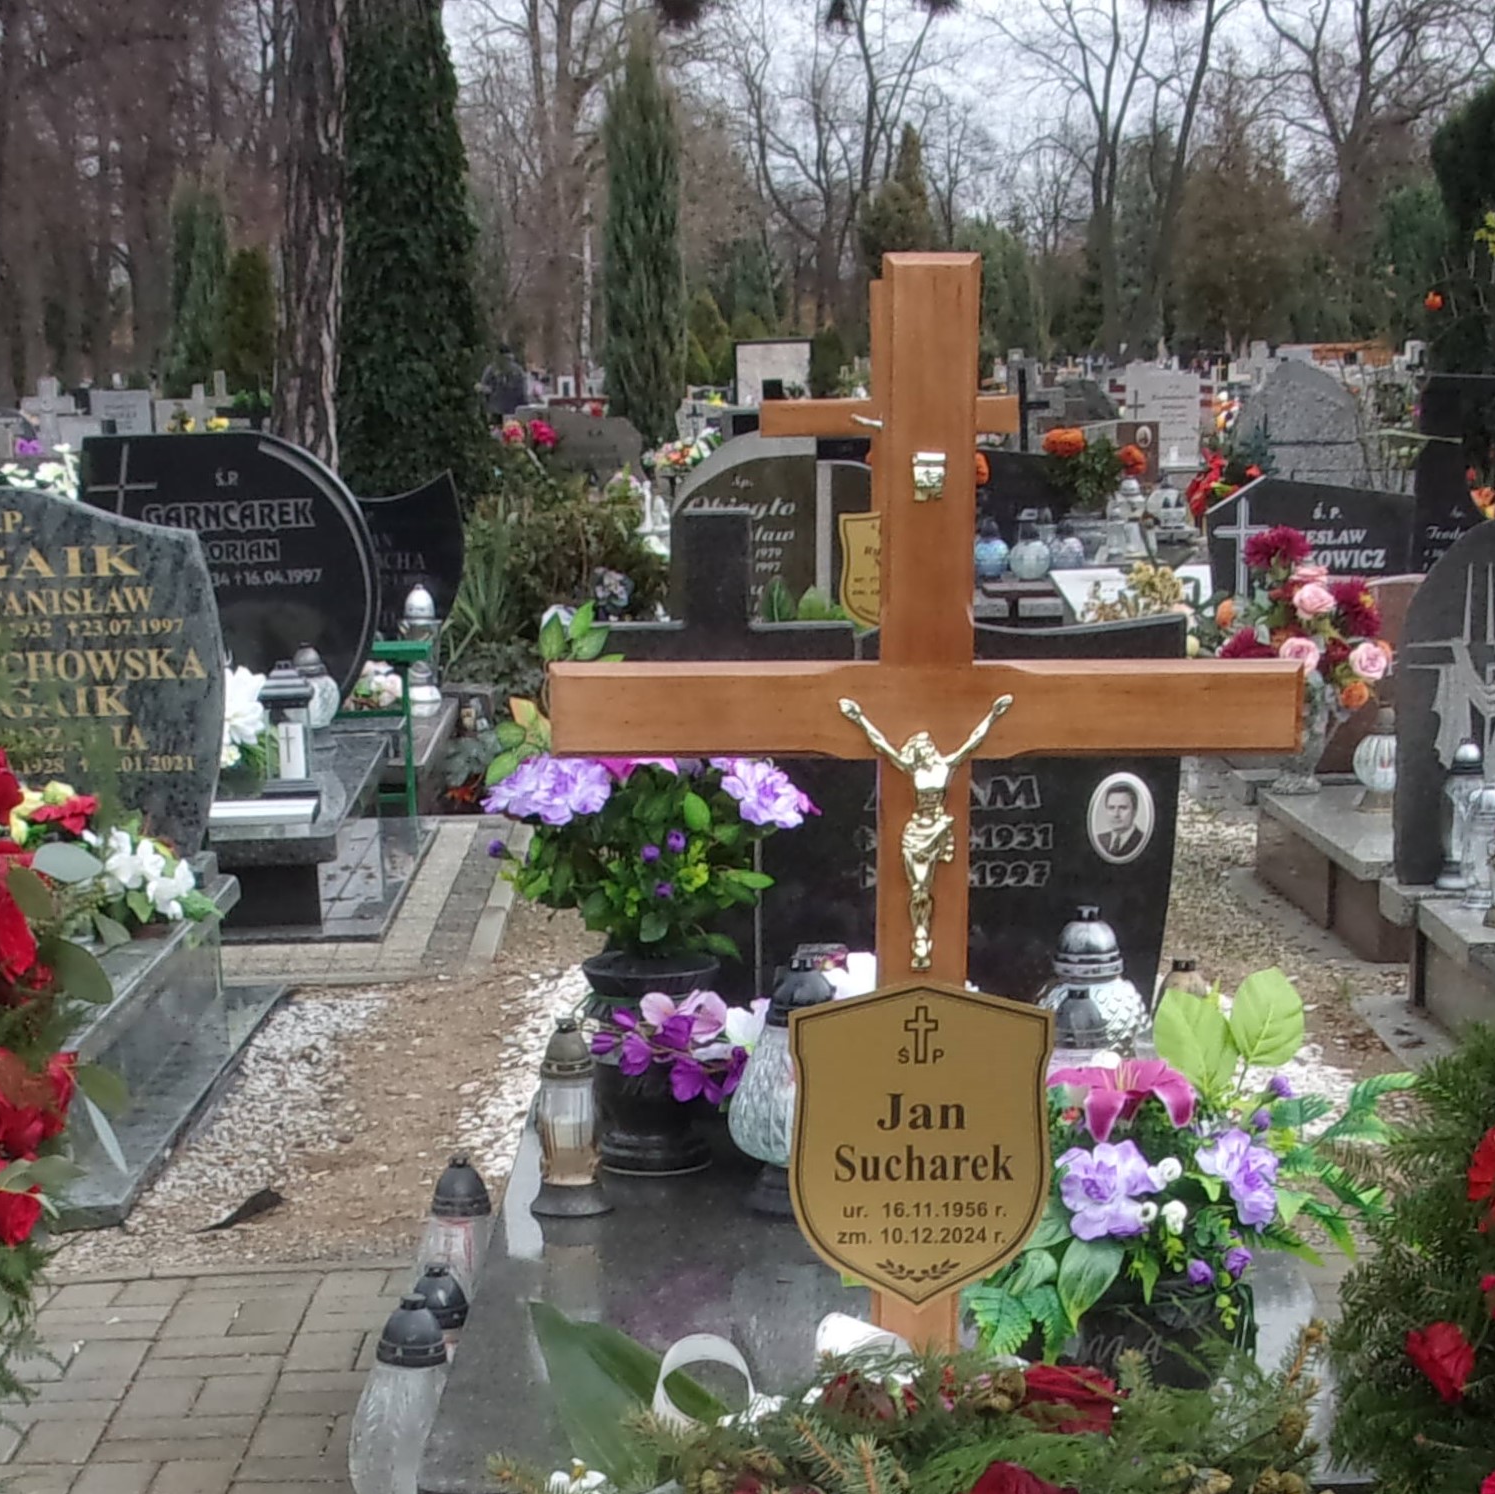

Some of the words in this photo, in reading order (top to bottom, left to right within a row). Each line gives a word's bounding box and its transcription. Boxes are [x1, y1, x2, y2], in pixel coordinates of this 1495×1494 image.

[142, 499, 315, 532] GARNCAREK
[206, 539, 280, 563] ORIAN
[1, 648, 206, 683] CHOWSKA
[897, 1046, 911, 1064] Ś
[931, 1049, 944, 1064] P
[876, 1092, 966, 1131] Jan
[833, 1143, 1014, 1183] Sucharek
[842, 1206, 869, 1219] ur.
[882, 1201, 988, 1219] 16.11.1956
[994, 1207, 1007, 1219] r.
[837, 1230, 873, 1245] zm.
[880, 1226, 987, 1245] 10.12.2024
[993, 1232, 1006, 1244] r.
